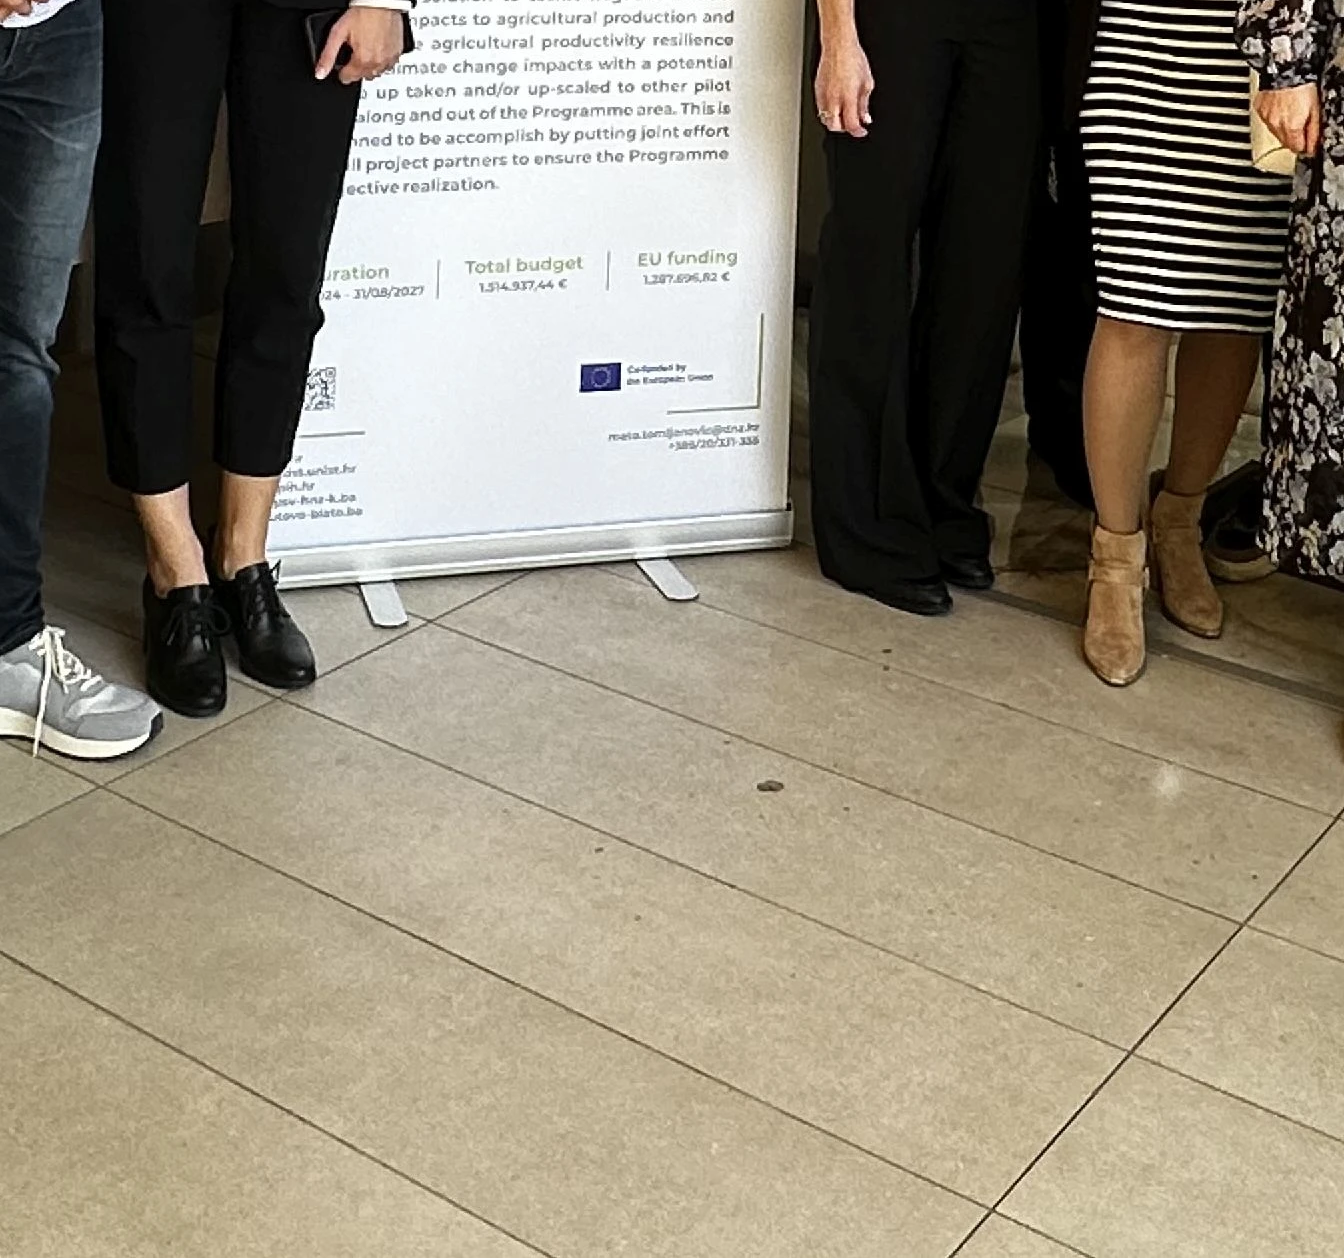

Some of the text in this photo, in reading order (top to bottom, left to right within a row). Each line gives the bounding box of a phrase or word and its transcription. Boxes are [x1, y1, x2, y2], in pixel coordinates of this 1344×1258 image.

[472, 13, 491, 26] to
[496, 10, 598, 29] agricultural
[603, 9, 697, 27] production
[702, 10, 735, 24] and
[431, 35, 534, 53] agricultural
[541, 32, 646, 51] productivity
[652, 32, 734, 47] resilience
[452, 58, 518, 76] change
[523, 57, 593, 75] impacts
[598, 56, 636, 71] with
[641, 59, 652, 71] a
[656, 54, 733, 73] potential
[376, 88, 399, 102] up
[406, 84, 456, 98] taken
[463, 82, 521, 98] and/or
[528, 80, 611, 98] up-scaled
[617, 80, 635, 93] to
[641, 79, 688, 93] other
[694, 78, 732, 95] pilot
[409, 107, 442, 122] and
[446, 107, 475, 121] out
[478, 105, 497, 120] of
[500, 105, 528, 120] the
[532, 104, 634, 121] Programme
[636, 102, 678, 116] area.
[680, 100, 715, 115] This
[718, 100, 731, 115] is
[397, 133, 415, 146] to
[419, 132, 441, 146] be
[444, 127, 544, 146] accomplish
[549, 128, 571, 144] by
[574, 127, 637, 144] putting
[640, 125, 680, 141] joint
[682, 124, 730, 138] effort
[365, 155, 429, 174] project
[432, 155, 508, 172] partners
[512, 153, 530, 166] to
[533, 152, 592, 165] ensure
[596, 150, 624, 163] the
[628, 148, 730, 165] Programme
[402, 176, 500, 193] realization.
[464, 255, 584, 275] Total budget
[638, 249, 739, 268] EU funding
